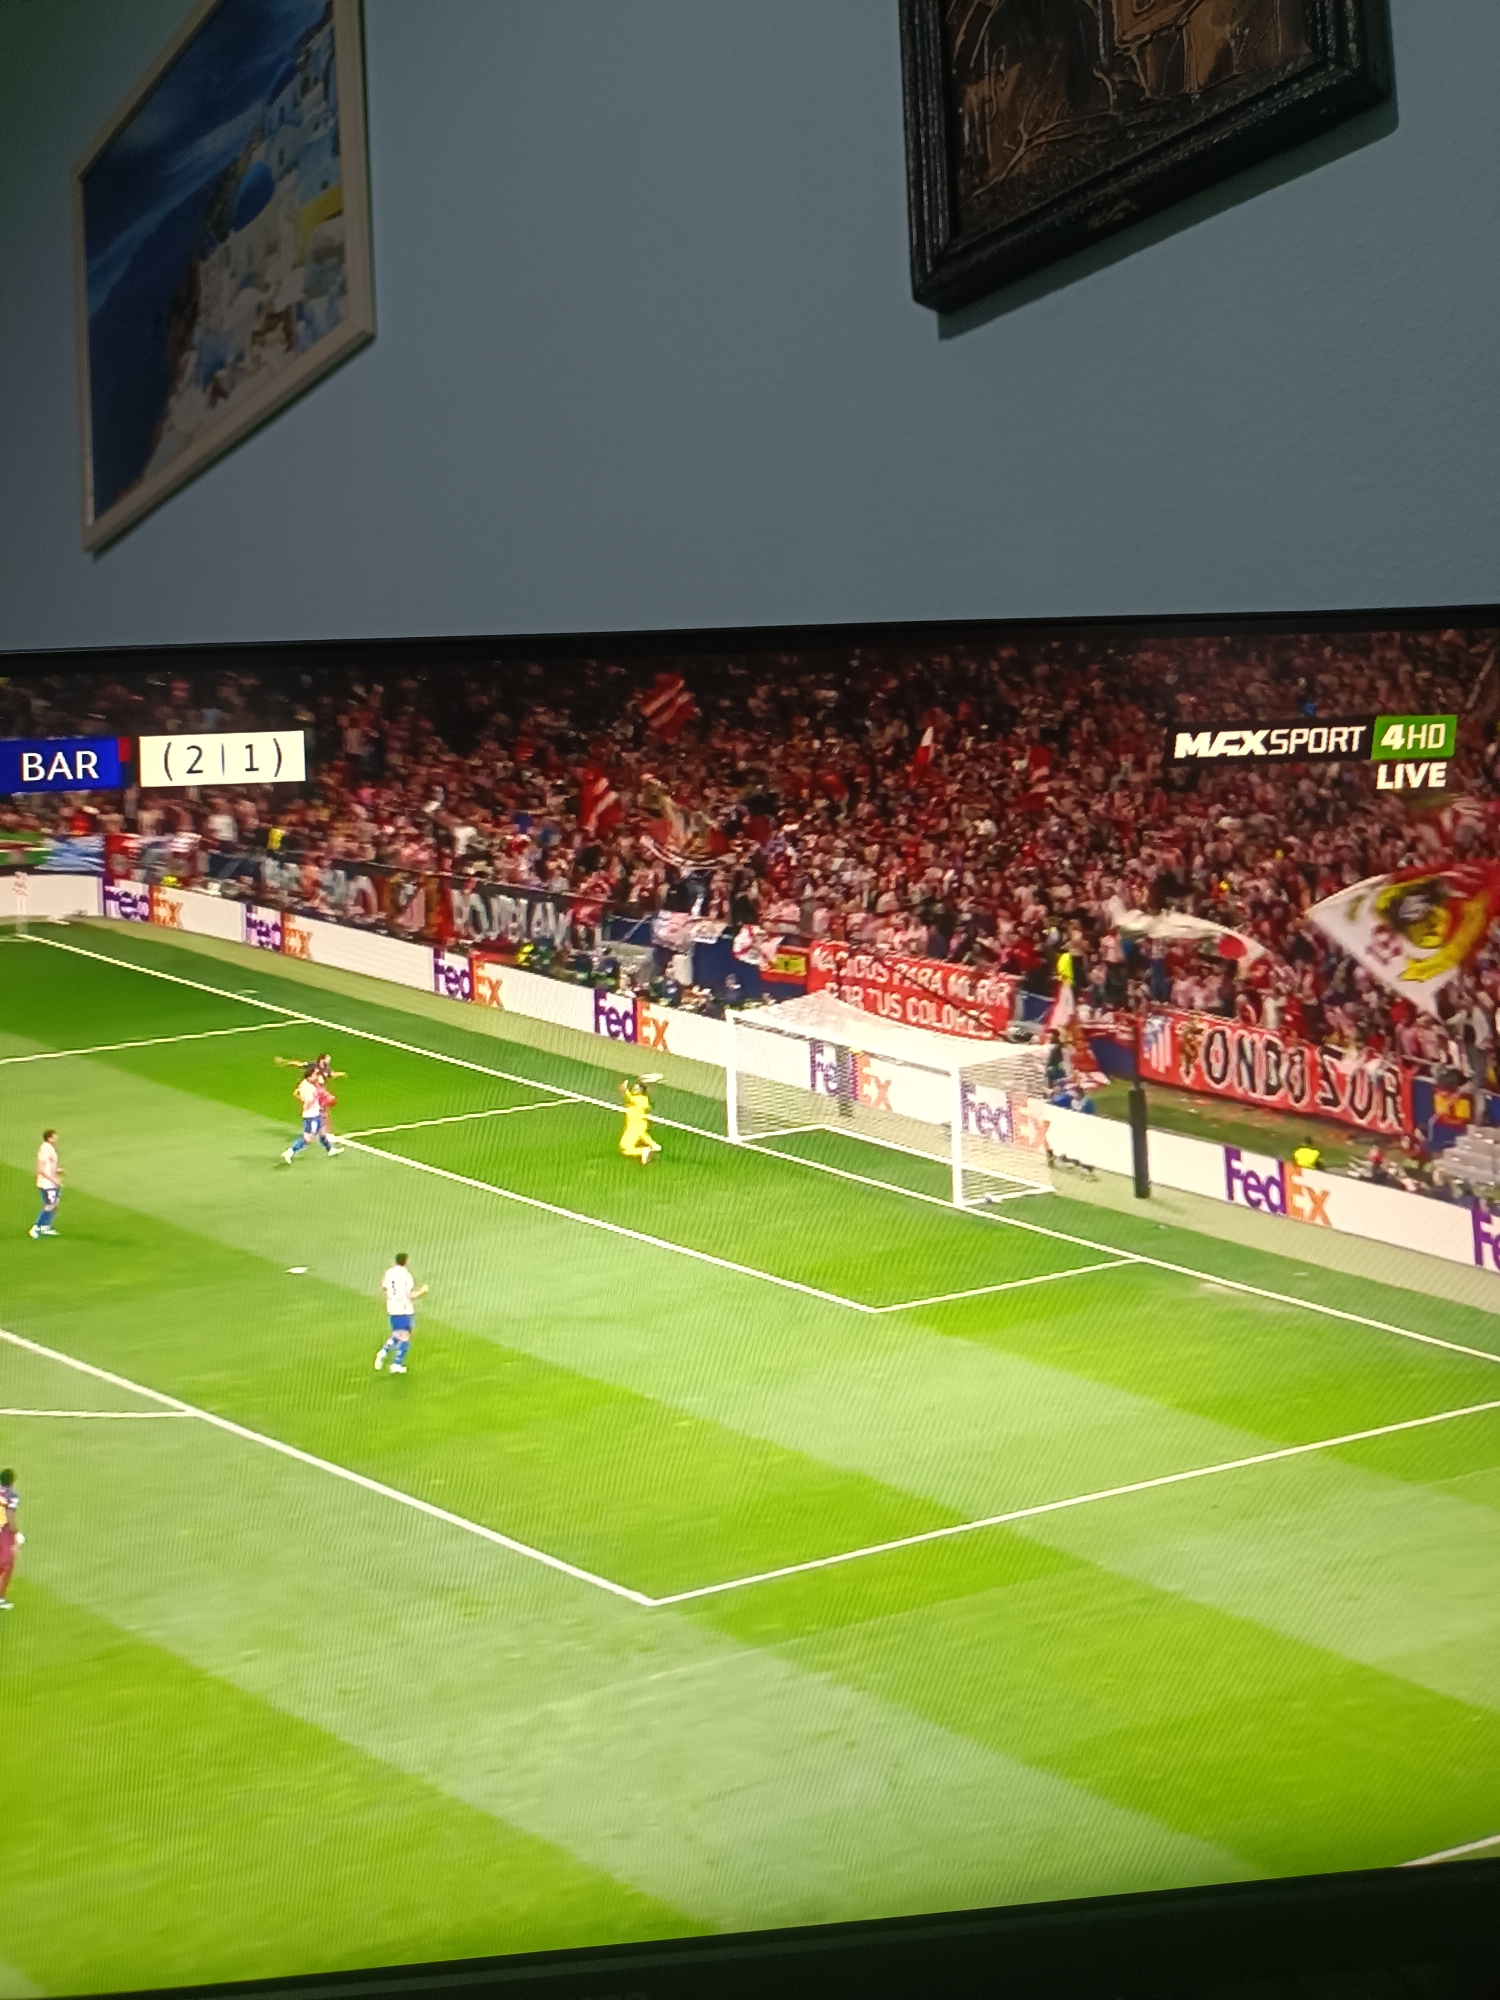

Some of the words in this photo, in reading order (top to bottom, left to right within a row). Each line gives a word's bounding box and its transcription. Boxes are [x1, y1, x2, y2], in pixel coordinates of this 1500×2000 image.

[22, 751, 99, 781] BAR
[1376, 762, 1447, 789] LIVE
[433, 947, 503, 1009] FedEx
[594, 988, 671, 1052] FedEx
[1224, 1146, 1332, 1227] FedEx
